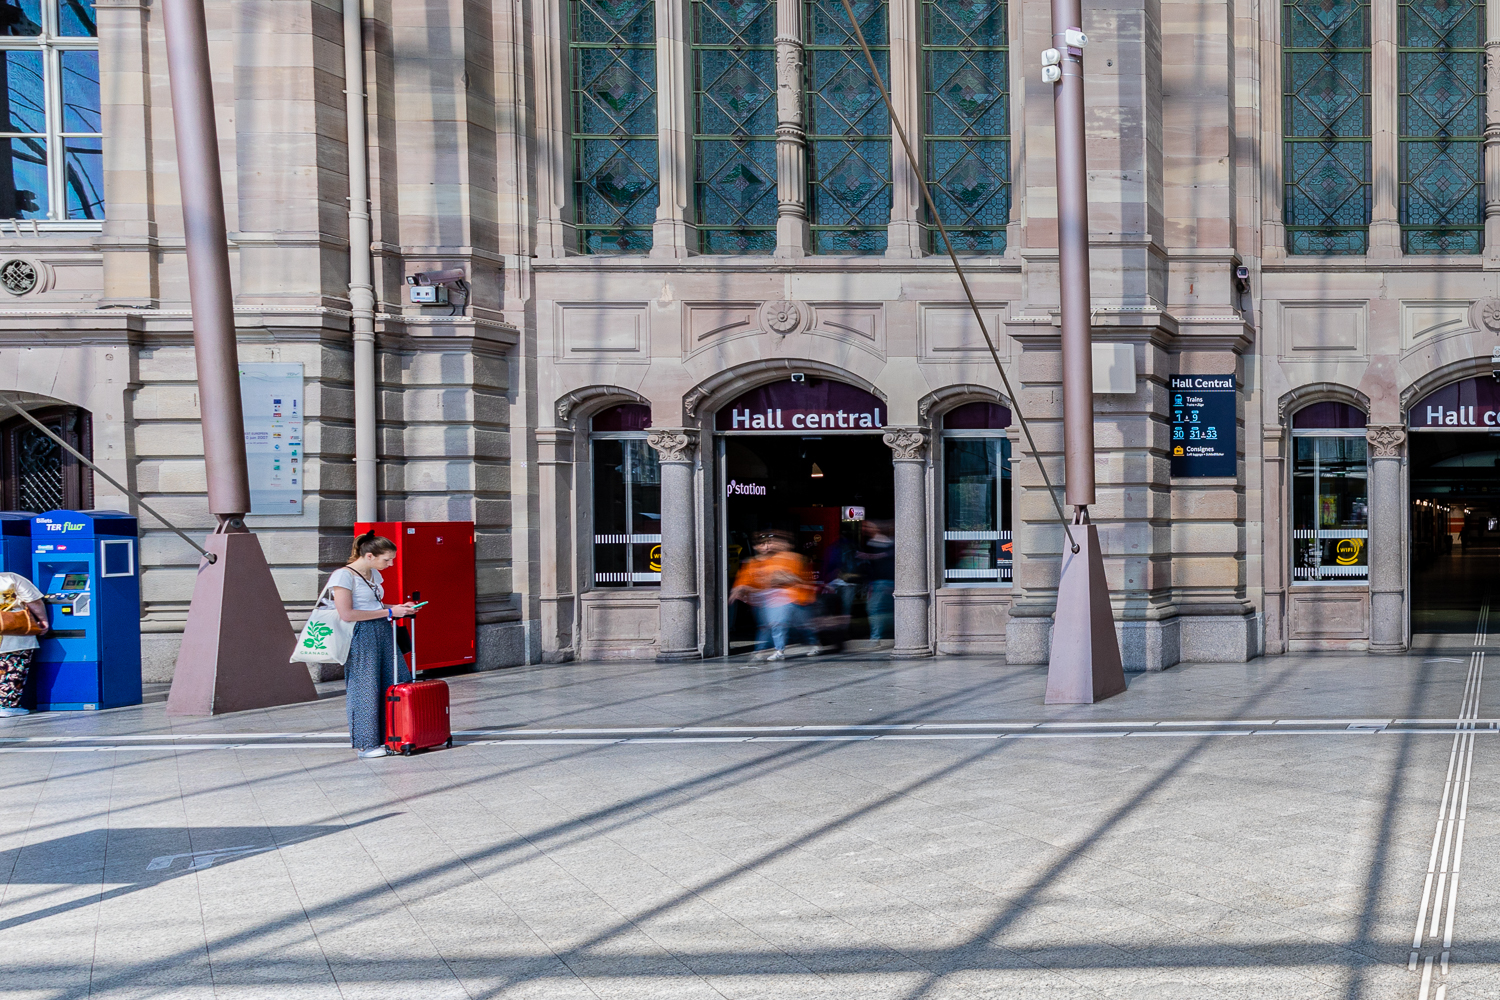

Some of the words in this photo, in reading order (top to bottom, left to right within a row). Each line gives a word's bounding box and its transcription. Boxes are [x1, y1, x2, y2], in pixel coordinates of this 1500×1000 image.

[1172, 378, 1193, 388] Hall
[1194, 378, 1233, 388] Central
[732, 408, 785, 429] Hall
[791, 407, 883, 429] central
[1175, 413, 1181, 421] 1
[1192, 413, 1198, 421] 9
[1426, 405, 1476, 425] Hall
[1173, 430, 1184, 438] 30
[1190, 430, 1200, 438] 31
[1206, 430, 1217, 438] 33
[1186, 445, 1214, 453] Consignes
[46, 523, 62, 531] TER
[61, 521, 86, 534] fluo
